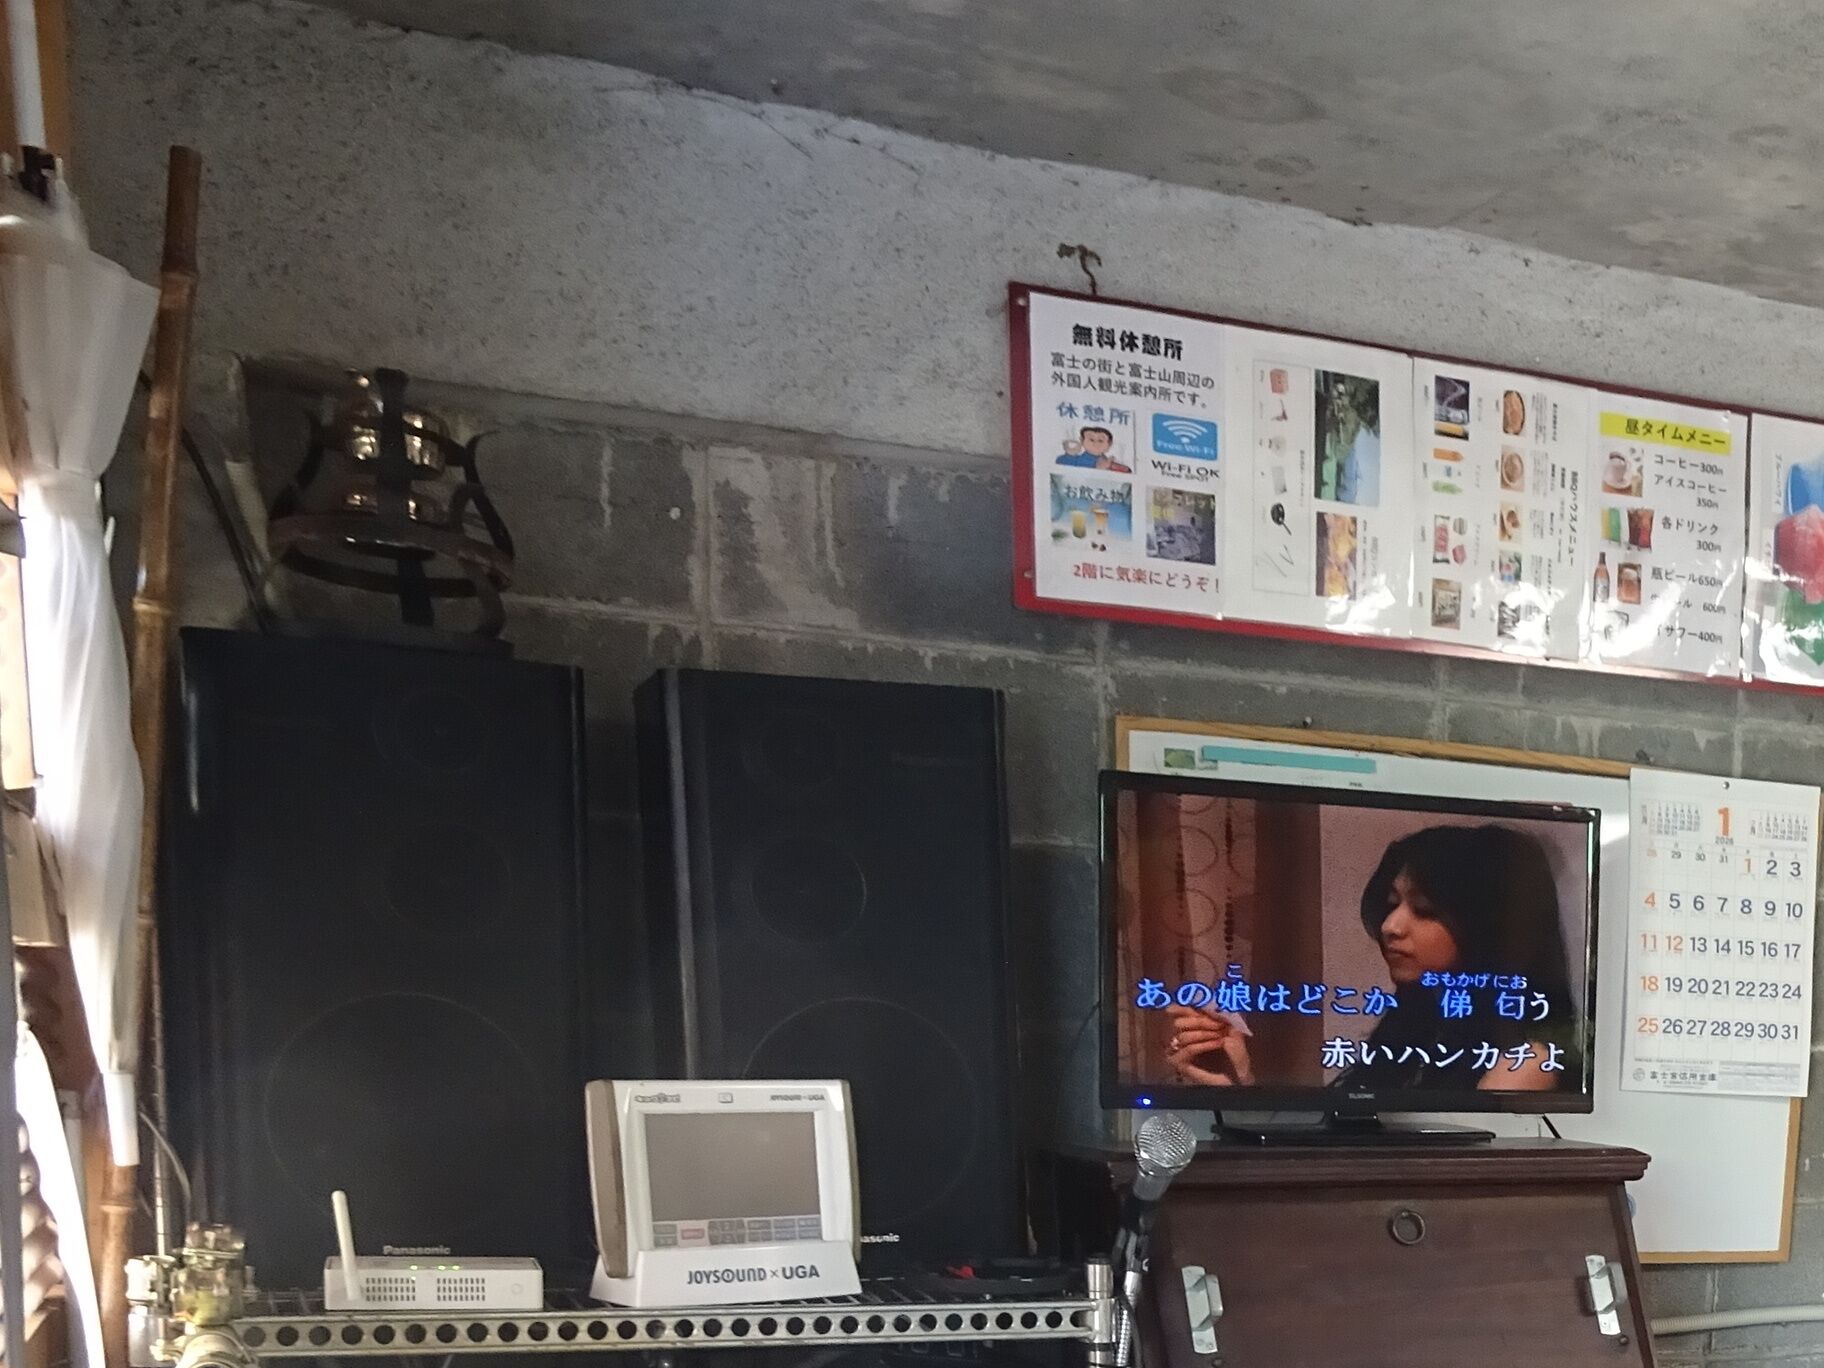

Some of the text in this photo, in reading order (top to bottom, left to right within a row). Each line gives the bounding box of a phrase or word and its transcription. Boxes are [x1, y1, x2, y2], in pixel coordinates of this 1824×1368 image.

[1071, 323, 1183, 361] 無料休憩所
[1050, 352, 1215, 390] 富士の街と富士山周辺の
[1051, 373, 1208, 408] 外国人観光案内所です。
[1056, 401, 1132, 426] 休憩所
[1625, 418, 1726, 446] 昼タイムメニー
[1196, 466, 1221, 478] OK
[1064, 484, 1127, 504] お飲み物
[1653, 474, 1727, 495] アイスコーヒー
[1661, 516, 1719, 536] 各ドリンク
[1717, 807, 1731, 837] 1
[1744, 858, 1752, 874] 1
[1766, 859, 1778, 876] 2
[1790, 861, 1802, 878] 3
[1644, 891, 1803, 919] 4 5 6 7 8 9 10
[1640, 934, 1801, 959] 11 12 13 14 15 16 17
[1226, 963, 1244, 979] こ
[1421, 971, 1528, 990] おもかげ にお
[1135, 977, 1399, 1017] あの娘はどこか
[1496, 990, 1551, 1021] 匂う
[1640, 976, 1802, 1000] 18 19 20 21 22 23 24
[1637, 1017, 1799, 1040] 25 26 27 28 29 30 31
[1320, 1036, 1566, 1073] 赤いハンカチよ
[860, 1232, 900, 1244] asonic
[382, 1244, 451, 1257] Panasonic
[686, 1266, 767, 1285] JOYSOUND
[781, 1264, 820, 1280] UGA
